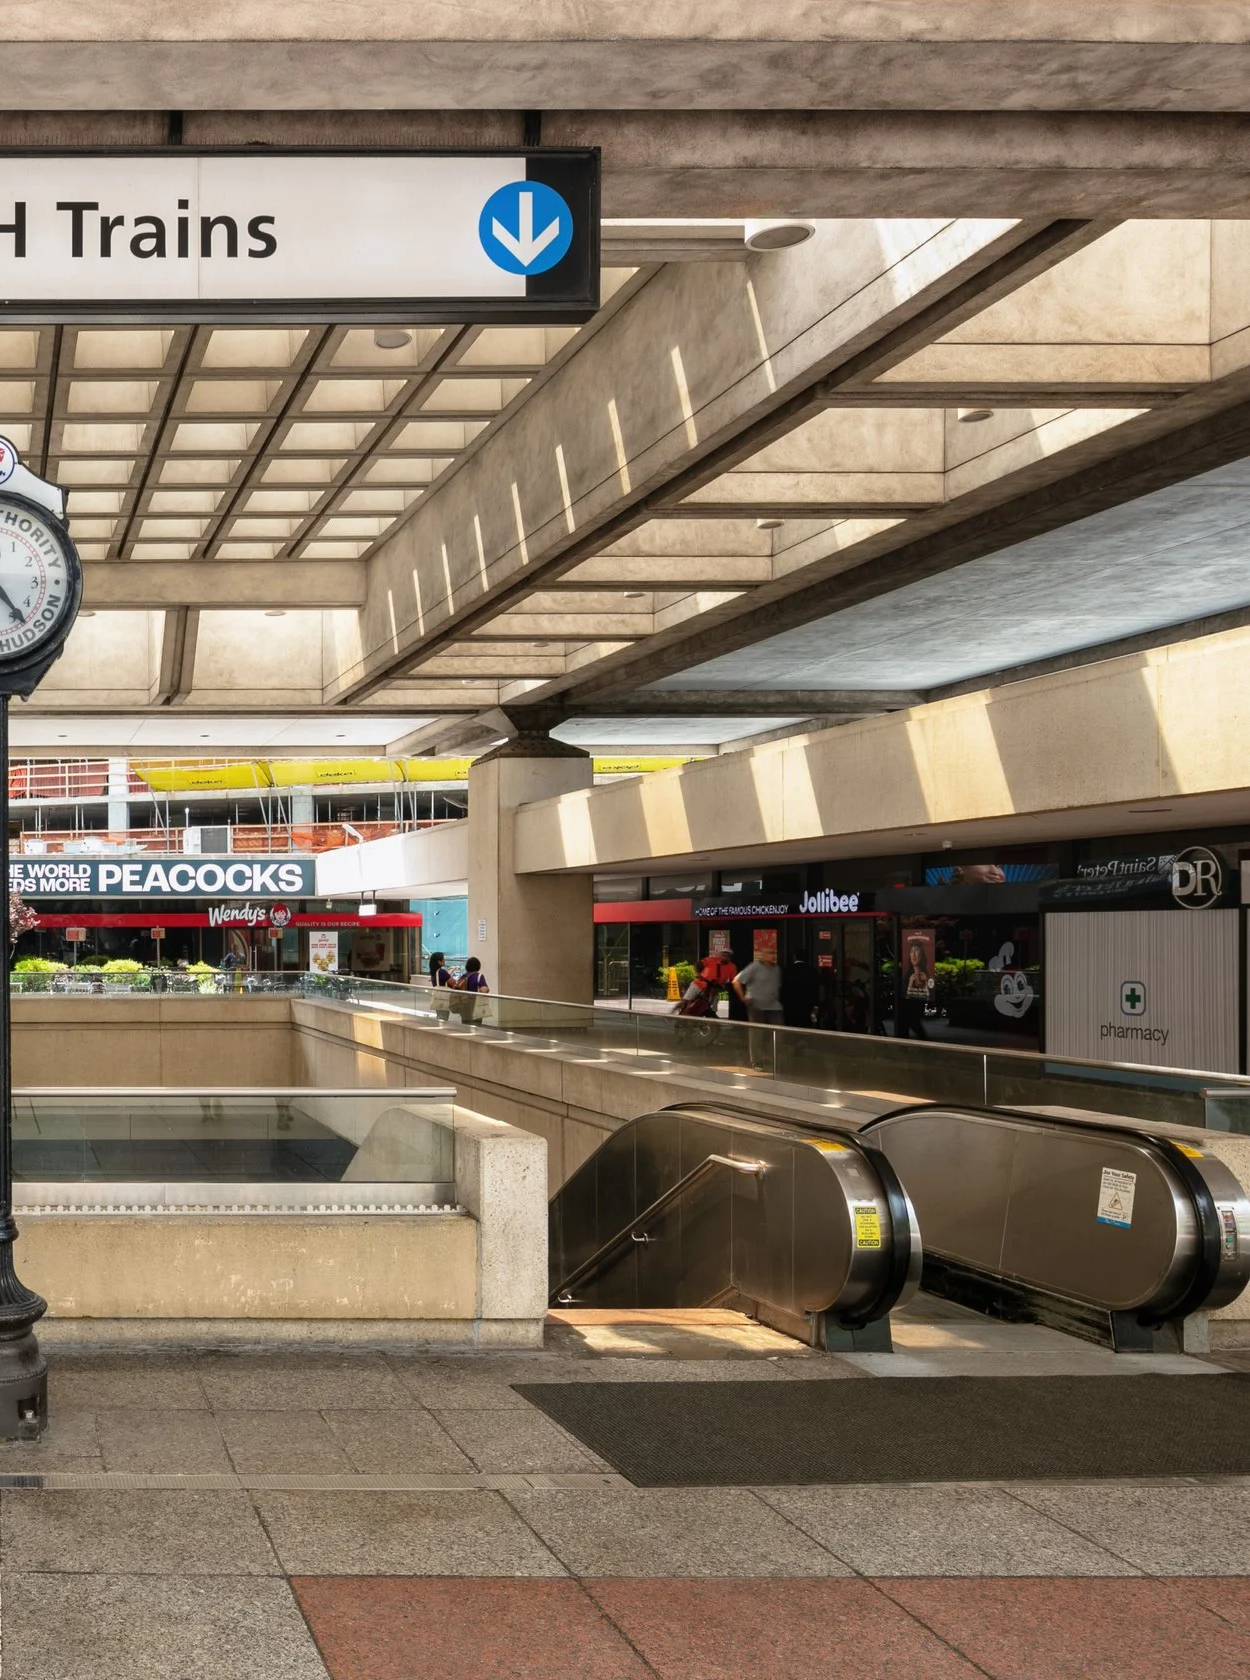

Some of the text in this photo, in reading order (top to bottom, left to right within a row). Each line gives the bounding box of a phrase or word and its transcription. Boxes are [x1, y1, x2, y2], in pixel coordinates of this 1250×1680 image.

[56, 198, 278, 259] Trains
[10, 541, 17, 552] 1
[25, 556, 33, 567] 2
[30, 576, 39, 588] 3
[22, 596, 32, 607] 4
[27, 864, 91, 878] WORLD
[98, 863, 303, 893] PEACOCKS
[40, 878, 91, 892] MORE
[799, 888, 859, 914] Jollibee
[208, 902, 266, 927] Wendy's
[695, 904, 789, 916] HOME OF THE FAMOUS CHICKENJOY
[1100, 1022, 1169, 1046] pharmacy
